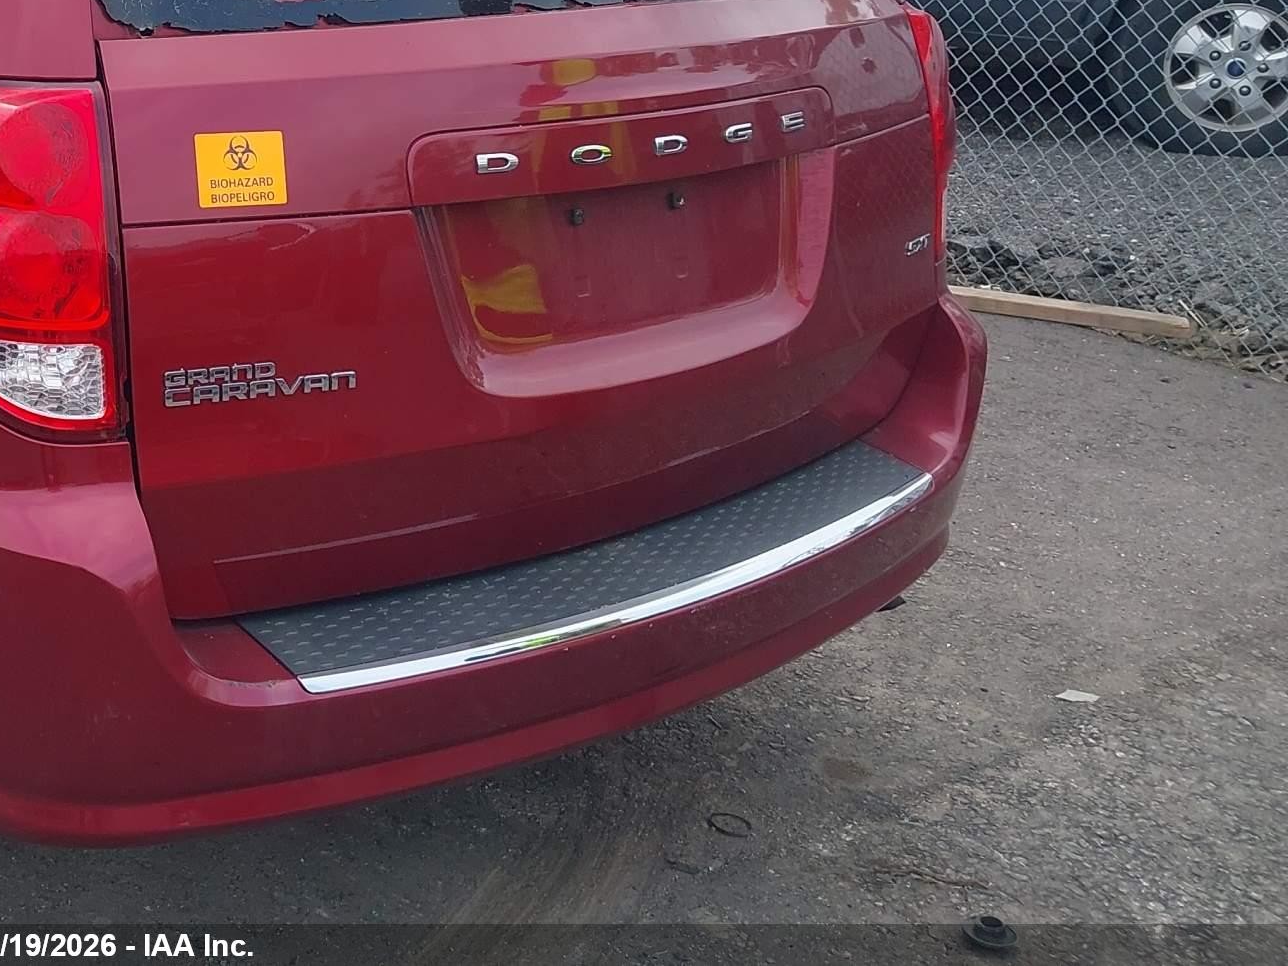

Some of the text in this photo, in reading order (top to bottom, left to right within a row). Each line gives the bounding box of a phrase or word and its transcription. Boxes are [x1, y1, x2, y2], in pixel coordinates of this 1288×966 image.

[475, 111, 805, 174] DODGE
[210, 177, 274, 189] BIOHAZARD
[211, 191, 275, 204] BIOPELIGRO
[164, 361, 276, 387] GRAND
[164, 371, 357, 408] CARAVAN
